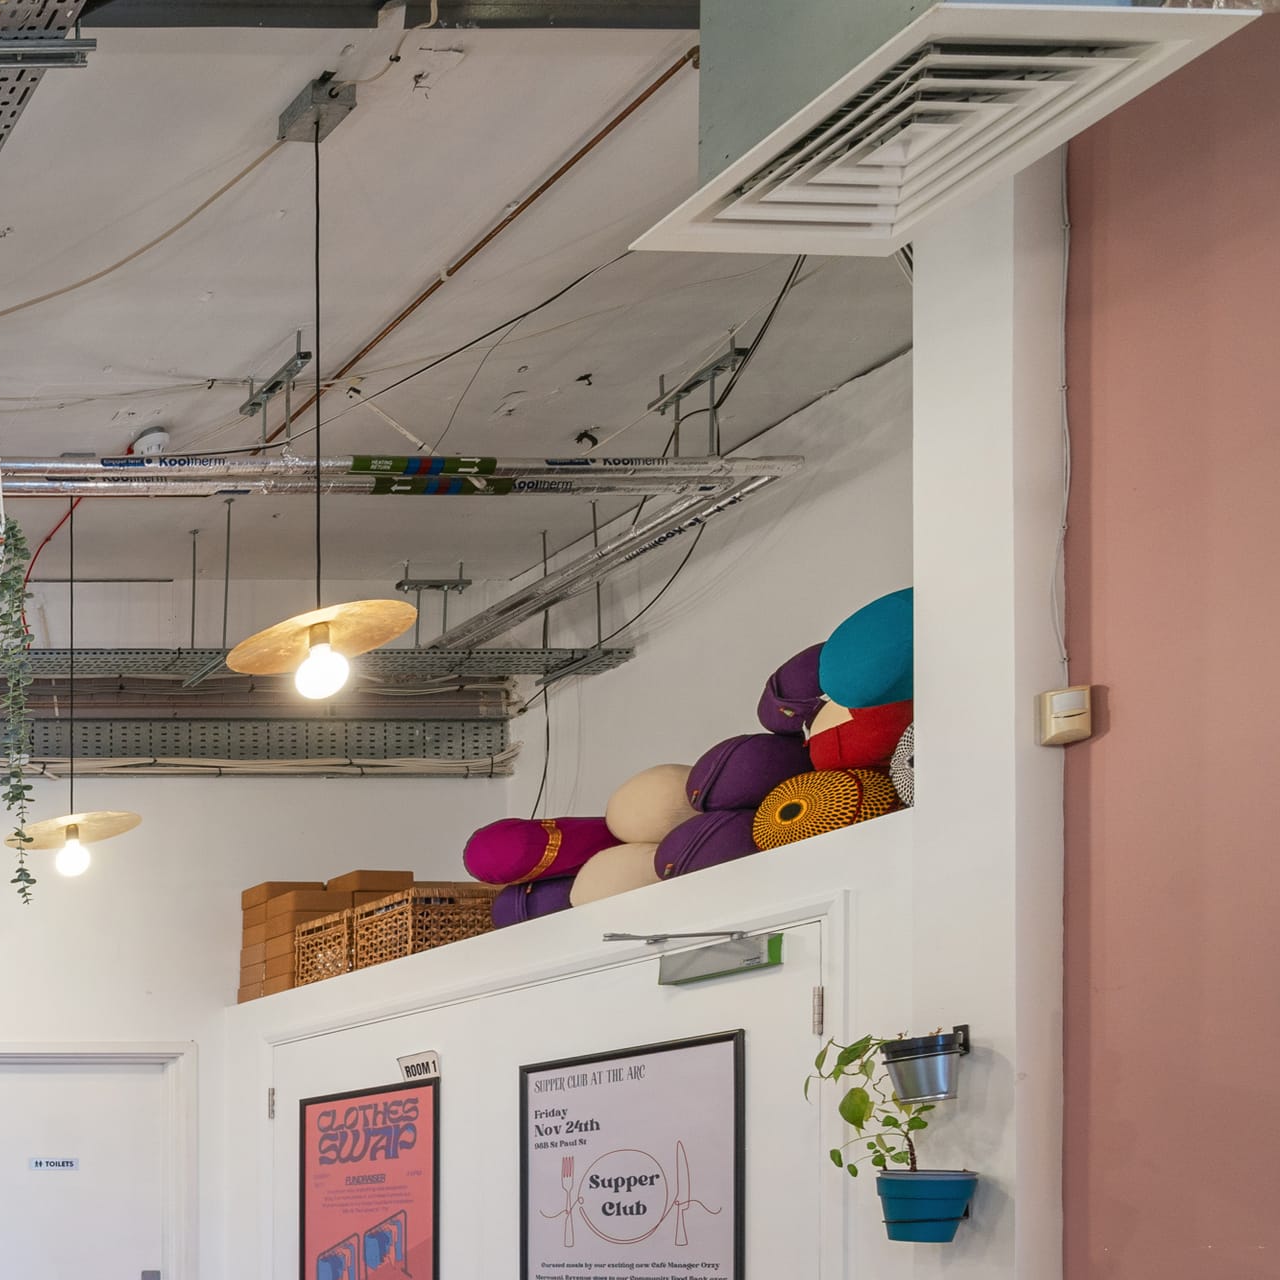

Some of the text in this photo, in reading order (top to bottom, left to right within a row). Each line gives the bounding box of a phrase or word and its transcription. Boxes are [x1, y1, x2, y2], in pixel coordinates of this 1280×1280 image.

[404, 1059, 438, 1079] ROOM 1
[534, 1063, 646, 1094] SUPPER CLUB AT THE ARC
[316, 1096, 420, 1133] CLOTHES
[533, 1107, 568, 1121] Friday
[533, 1118, 601, 1138] Nov 24th
[317, 1122, 418, 1167] SWAP
[559, 1139, 578, 1148] Paul
[45, 1160, 75, 1168] TOILETS
[344, 1173, 387, 1186] FUNDRAISER
[588, 1173, 661, 1194] Supper
[600, 1199, 648, 1217] Club
[667, 1261, 700, 1271] Manager
